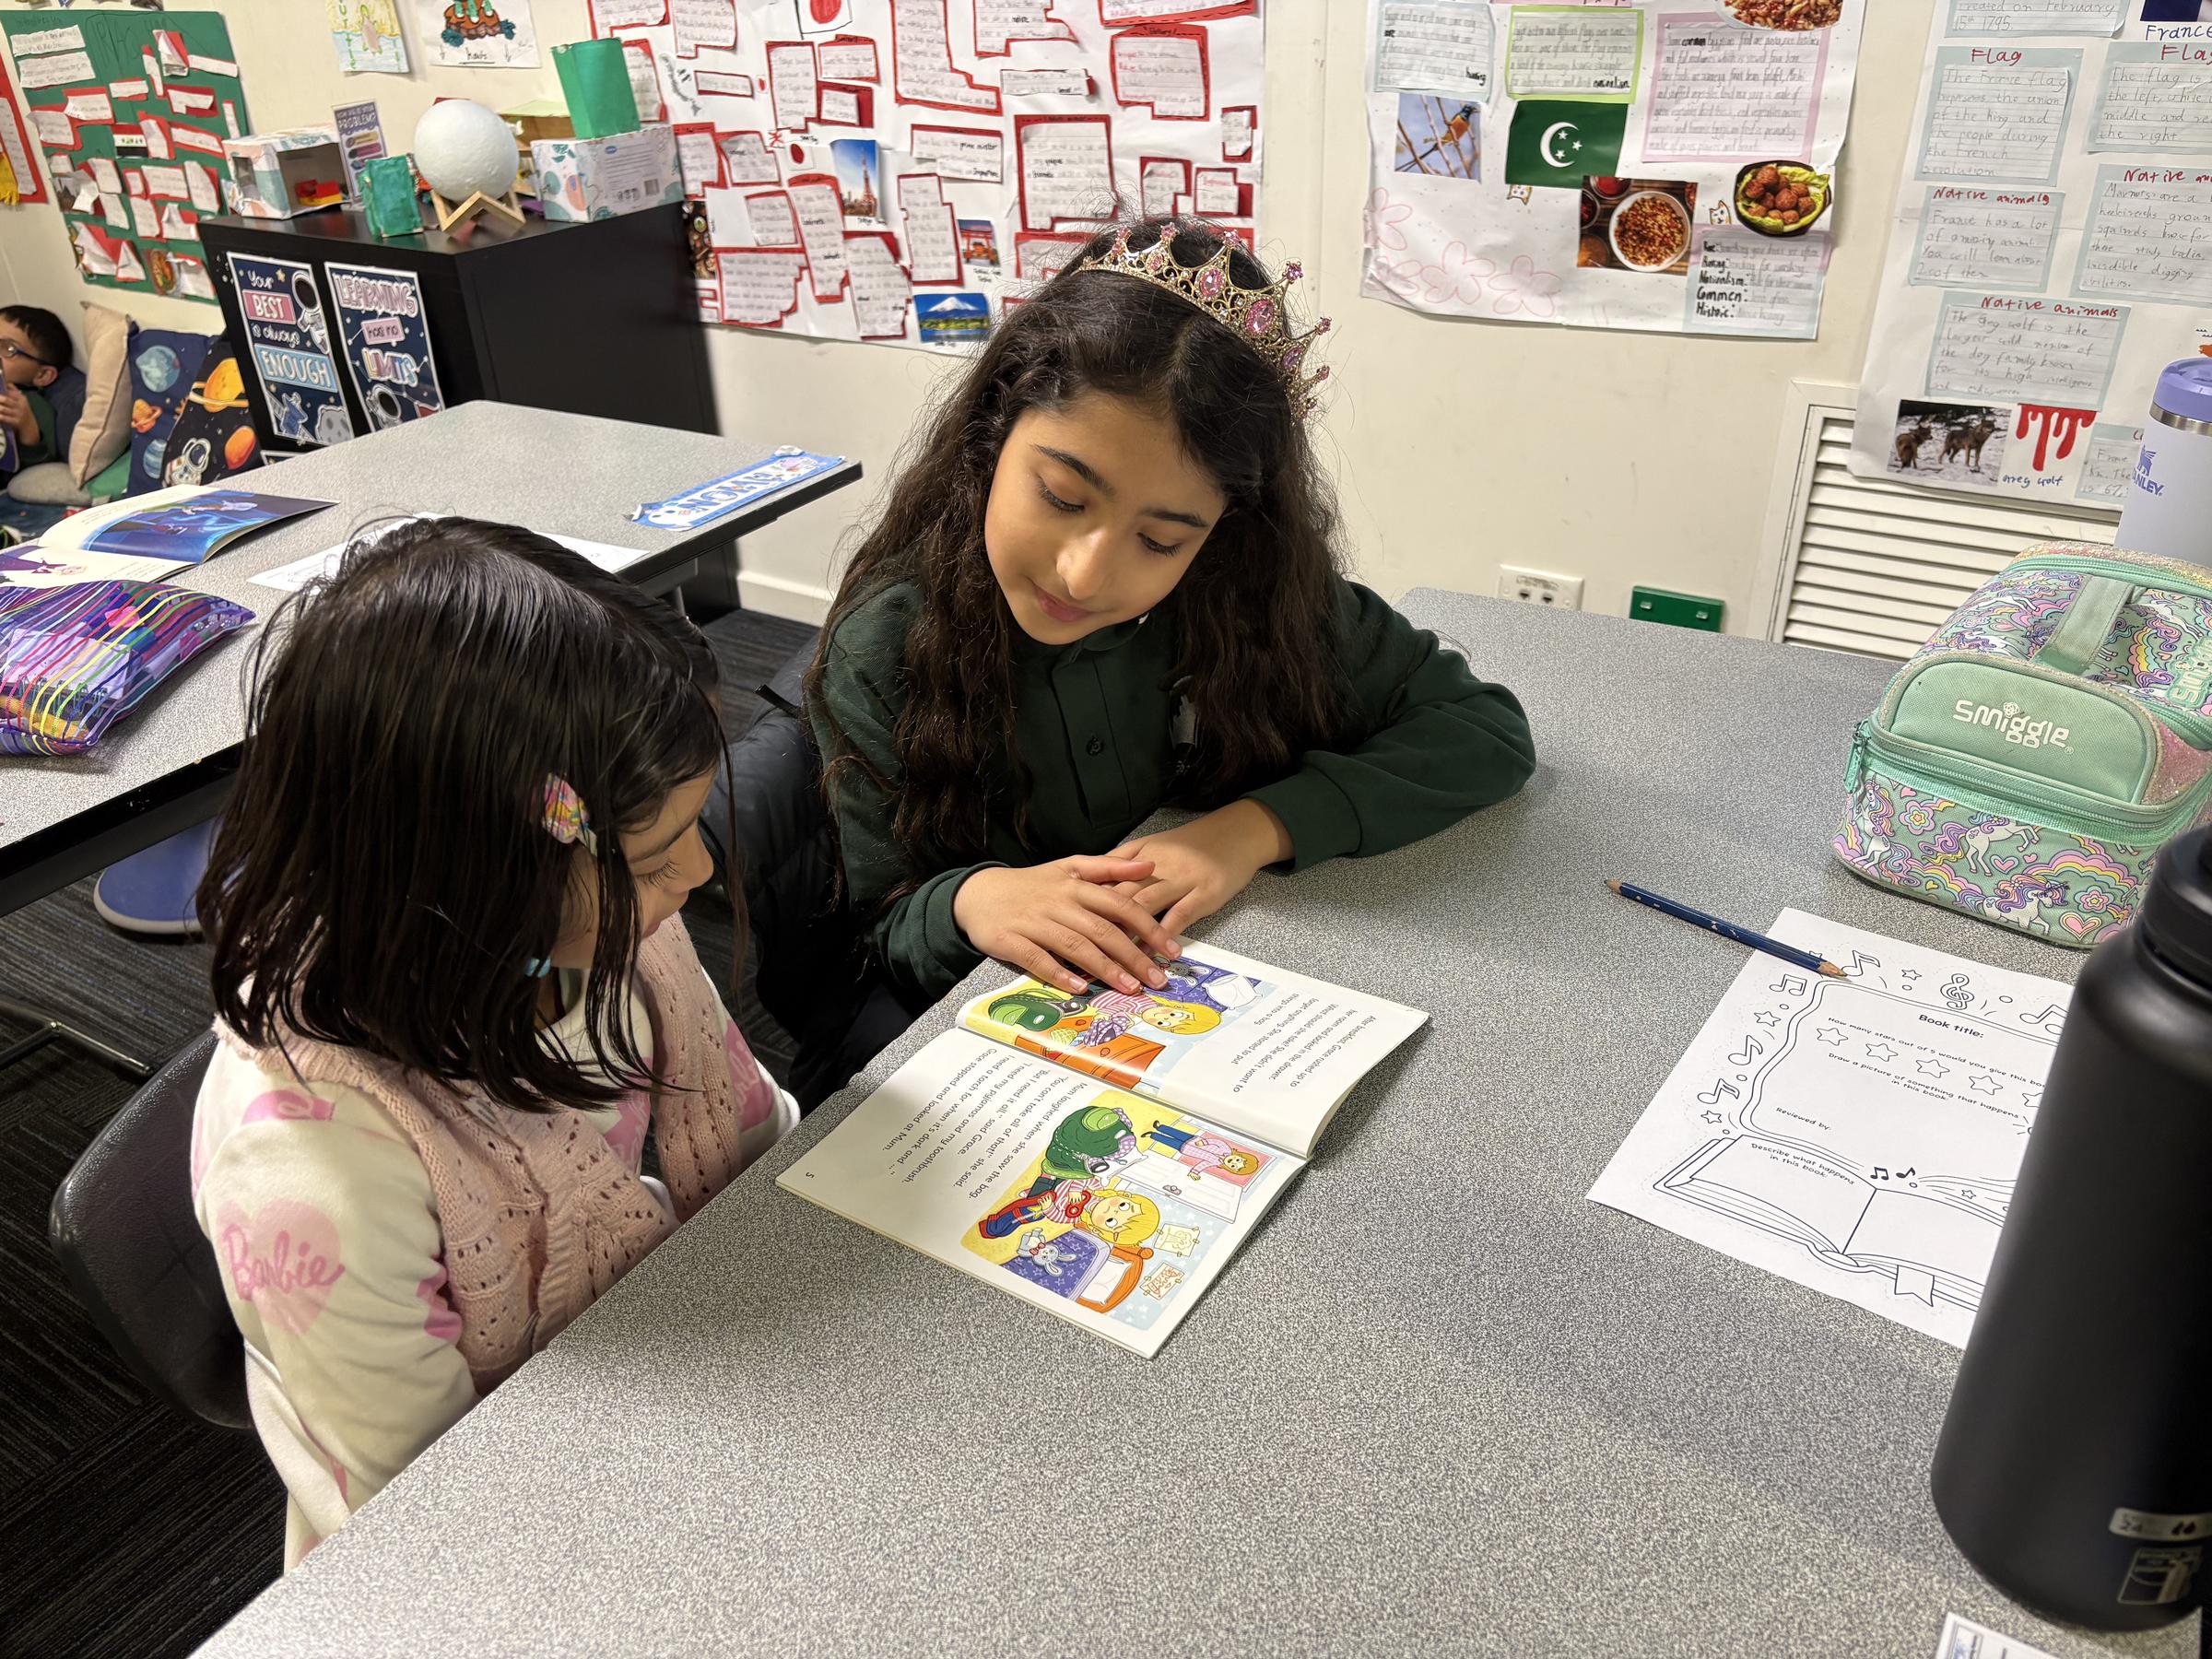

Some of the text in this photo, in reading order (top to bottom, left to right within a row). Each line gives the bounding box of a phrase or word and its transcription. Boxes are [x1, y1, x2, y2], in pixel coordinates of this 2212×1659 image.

[1971, 48, 2022, 66] Flag
[2028, 71, 2066, 92] flag
[2147, 67, 2181, 88] flag
[2124, 169, 2186, 182] Native
[333, 274, 418, 318] LEARNING
[251, 295, 285, 319] BEST
[1981, 296, 2119, 318] Native animals
[261, 350, 333, 388] ENOUGH
[361, 347, 418, 387] LIMITS
[1918, 1014, 1984, 1039] Book title:
[1828, 1017, 1847, 1026] How
[1849, 1024, 1872, 1034] many
[1874, 1032, 1896, 1041] stars
[1898, 1040, 1914, 1048] out
[1938, 1052, 1967, 1063] would
[1969, 1061, 1986, 1069] you
[1989, 1067, 2007, 1076] give
[2010, 1074, 2027, 1082] this
[992, 1056, 1010, 1071] need
[1006, 1065, 1025, 1080] need
[968, 1075, 989, 1091] torch
[994, 1078, 1009, 1090] my
[1012, 1082, 1031, 1099] need
[1232, 1084, 1244, 1093] to
[1828, 1053, 1851, 1063] Draw
[1860, 1064, 1892, 1077] picture
[1907, 1079, 1954, 1099] something
[1958, 1095, 1978, 1105] that
[1980, 1101, 2018, 1119] happens
[1903, 1083, 1920, 1092] this
[882, 1048, 997, 1151] Grace stopped and looked at Mum.
[959, 1091, 972, 1103] for
[1033, 1087, 1052, 1102] can't
[968, 1088, 997, 1119] pyjamas
[1018, 1102, 1037, 1117] take
[938, 1103, 960, 1122] when
[1775, 1107, 1817, 1125] Reviewed
[928, 1122, 944, 1134] it's
[954, 1119, 970, 1134] and
[979, 1118, 995, 1135] said
[1009, 1117, 1021, 1128] all
[940, 1133, 956, 1146] my
[969, 1082, 1088, 1199] Mum laughed when she saw the bag.
[1002, 1127, 1012, 1138] of
[911, 1133, 930, 1150] dark
[957, 1134, 982, 1155] Grace.
[896, 1149, 913, 1165] and
[901, 1146, 945, 1183] toothbrush.
[970, 1157, 985, 1171] she
[1751, 1143, 1859, 1185] Describe what happens
[1782, 1158, 1799, 1168] this
[953, 1171, 972, 1188] said.
[222, 1223, 347, 1300] Barbie
